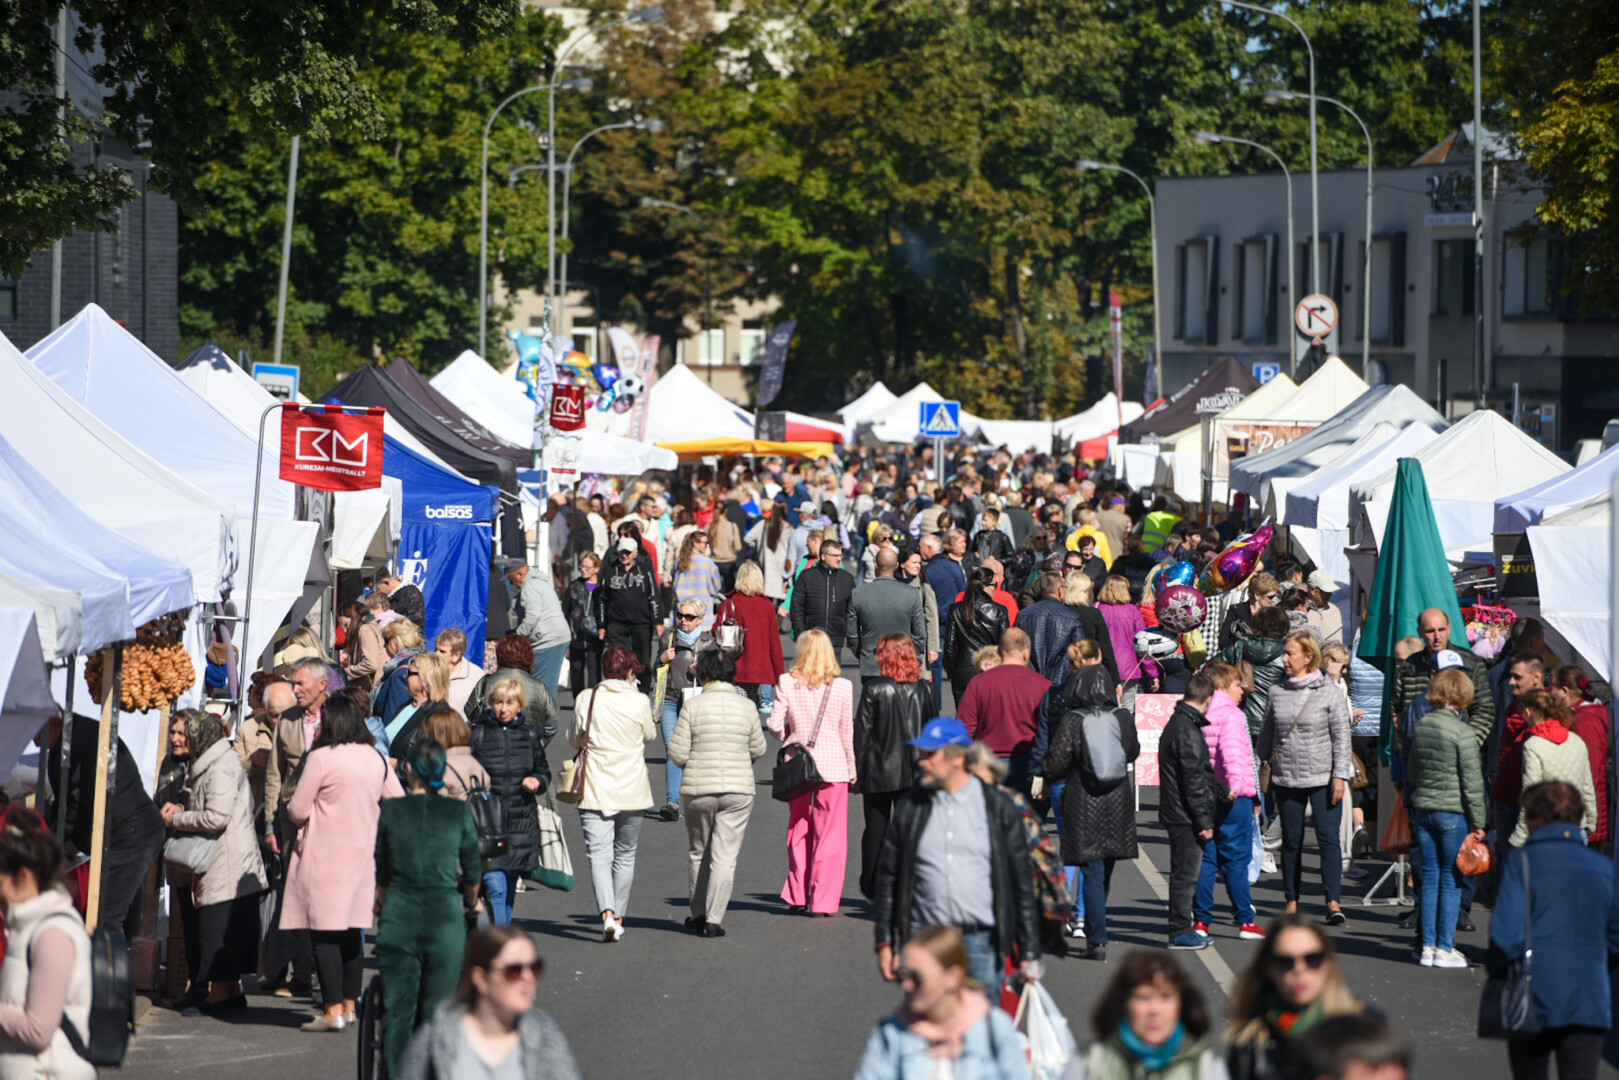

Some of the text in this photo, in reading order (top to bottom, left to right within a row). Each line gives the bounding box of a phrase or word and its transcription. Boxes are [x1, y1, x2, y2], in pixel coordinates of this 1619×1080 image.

[1260, 366, 1275, 385] P
[295, 426, 369, 467] KM
[425, 504, 473, 519] balsas
